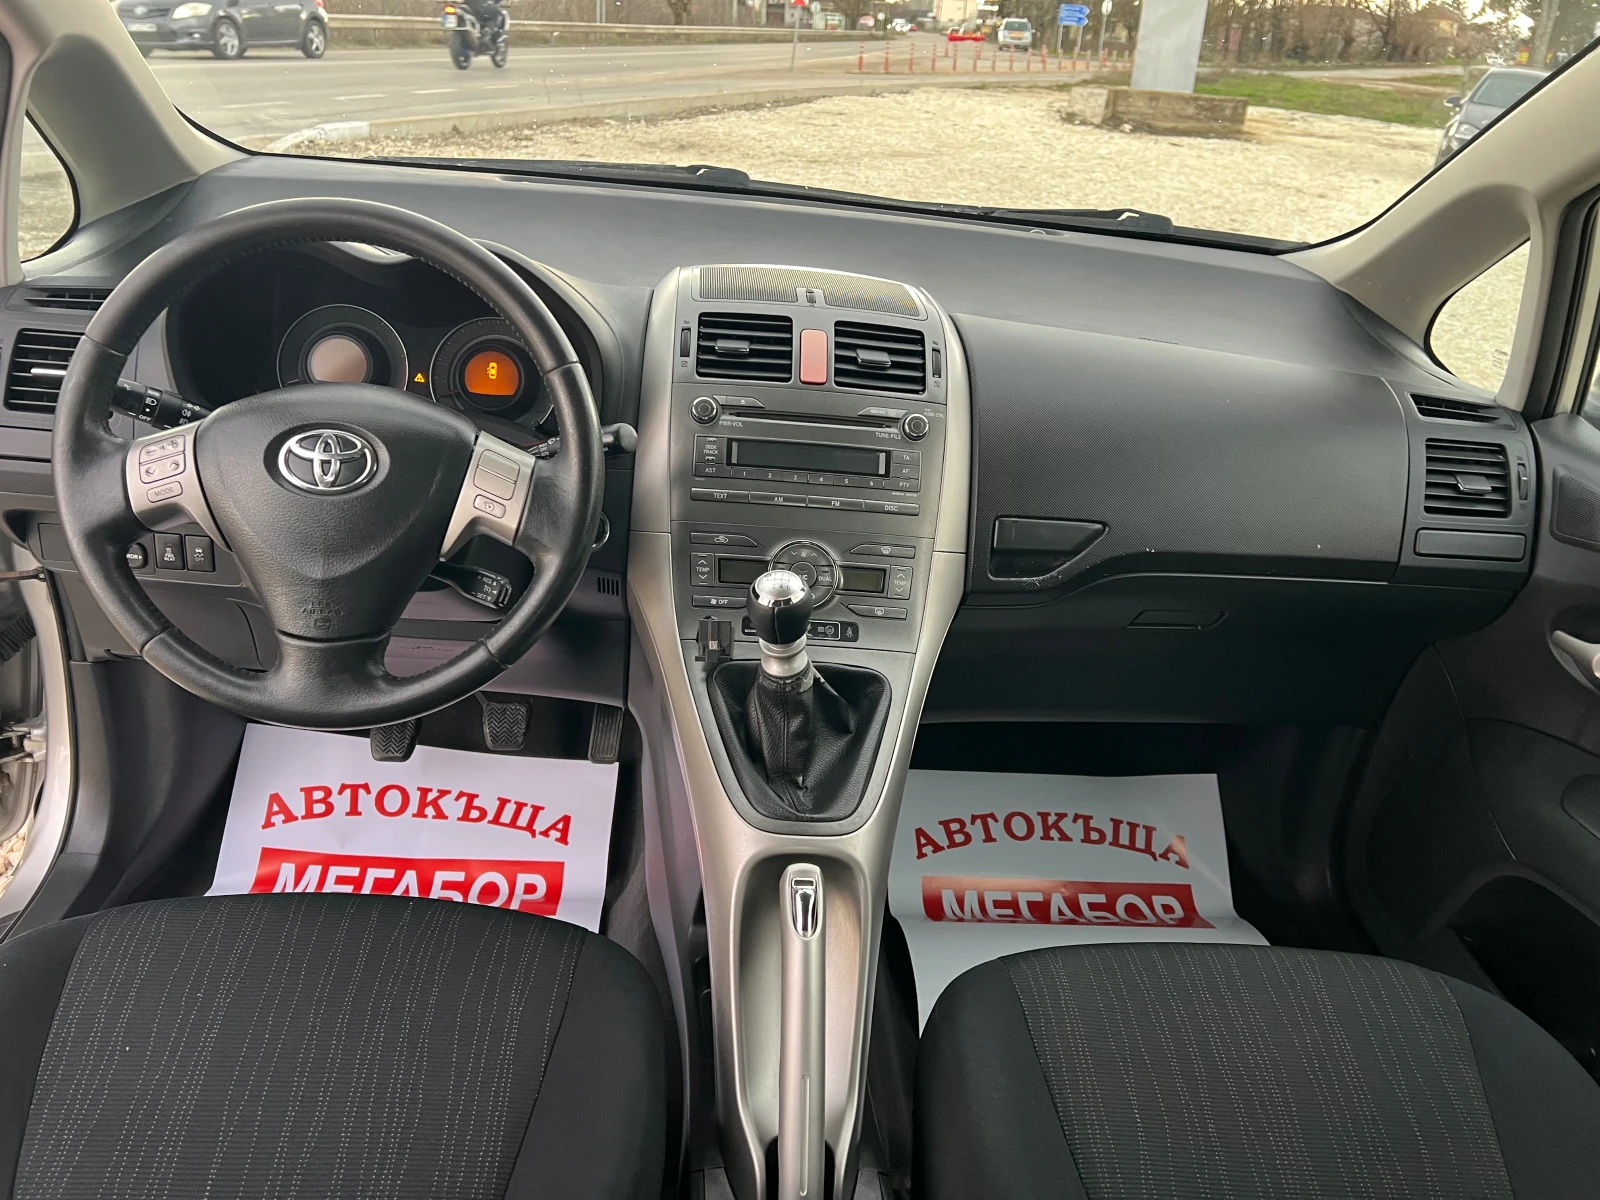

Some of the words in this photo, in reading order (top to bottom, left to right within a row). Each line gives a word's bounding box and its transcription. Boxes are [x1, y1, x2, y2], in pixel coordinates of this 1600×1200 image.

[154, 486, 175, 498] MODE
[884, 504, 899, 512] DISC
[261, 782, 572, 846] АВТОКЪЩА
[914, 811, 1190, 870] АВТОКЪЩА
[271, 862, 548, 911] МЕГАБОР
[941, 889, 1185, 925] МЕГАБОР
